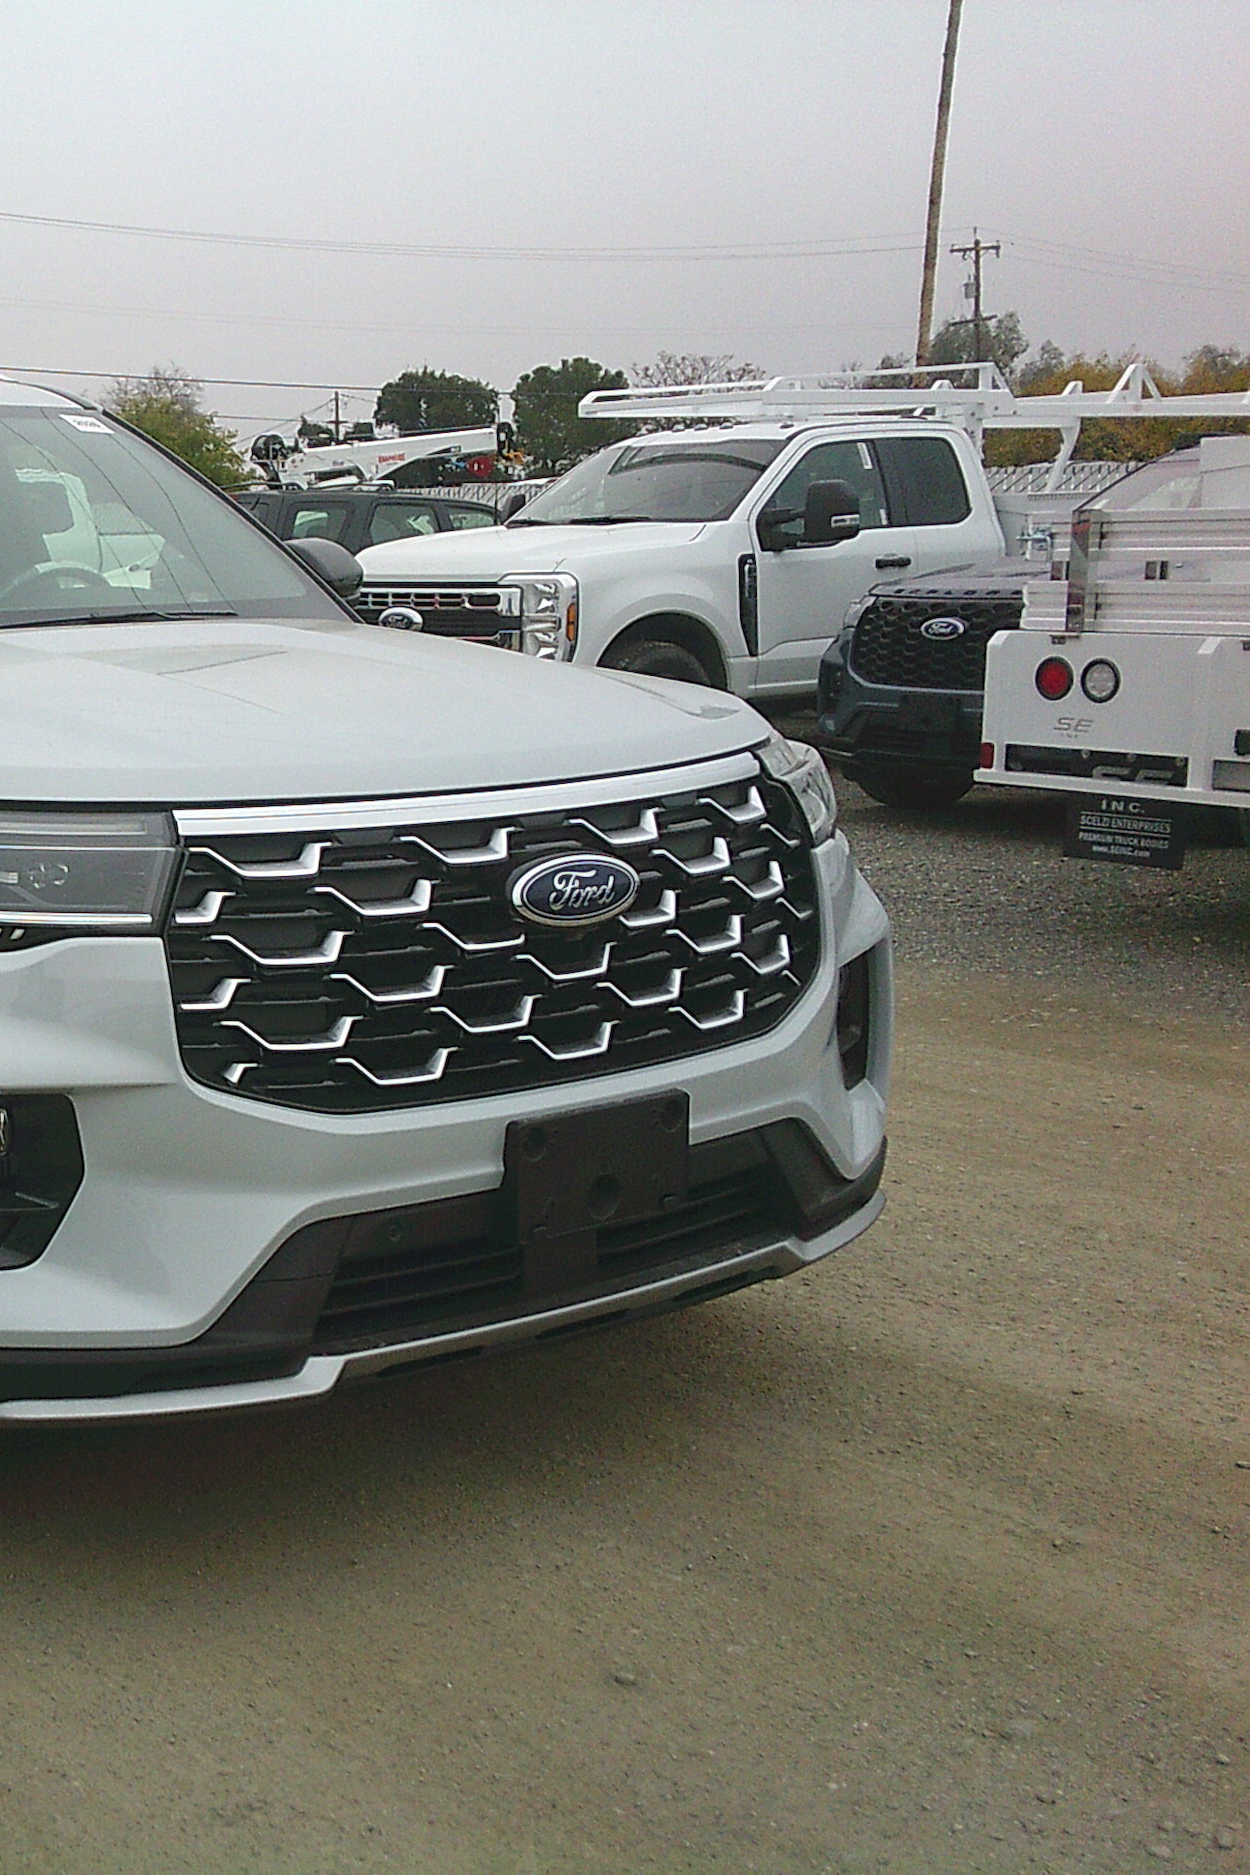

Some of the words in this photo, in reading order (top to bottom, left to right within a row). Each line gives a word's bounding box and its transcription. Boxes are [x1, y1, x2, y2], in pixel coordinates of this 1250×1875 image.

[928, 622, 954, 635] Ford
[1053, 717, 1095, 733] SE
[1101, 799, 1146, 814] INC.
[1111, 819, 1172, 834] ENTERPRISES
[1114, 835, 1139, 847] TRUCK
[548, 869, 615, 911] Ford
